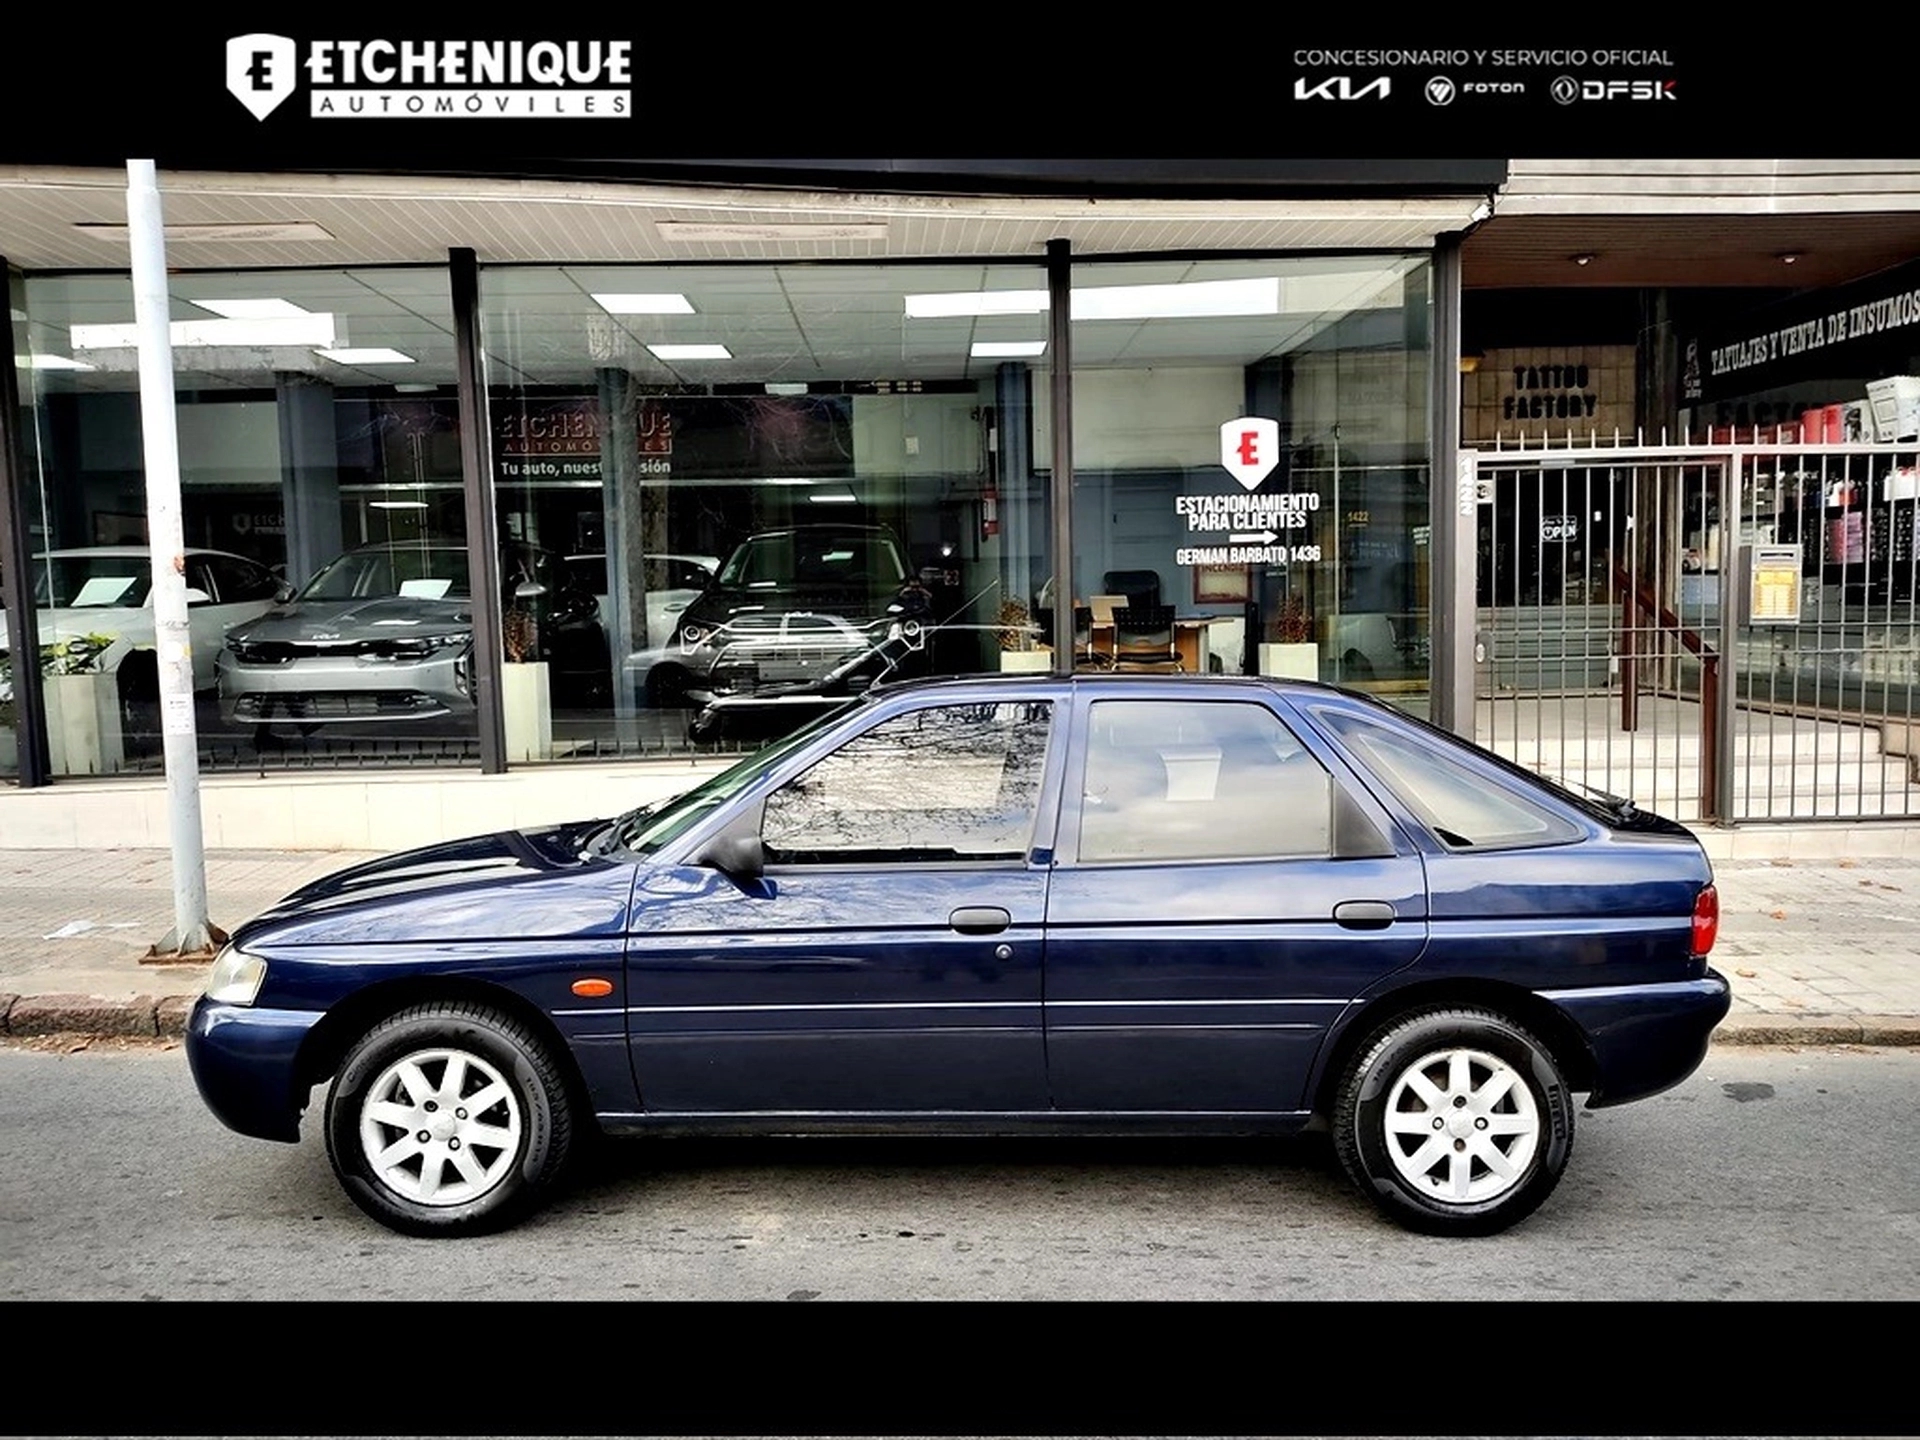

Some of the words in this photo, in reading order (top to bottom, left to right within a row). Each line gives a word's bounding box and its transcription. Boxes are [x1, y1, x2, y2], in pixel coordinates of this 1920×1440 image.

[1711, 335, 1768, 375] TATUAJES
[1769, 331, 1779, 360] Y
[1780, 318, 1825, 357] VENTA
[1827, 311, 1848, 344] DE
[1849, 289, 1920, 339] INSUMOS
[1513, 365, 1588, 389] TATTOO
[1503, 395, 1597, 419] FACTORY
[499, 413, 672, 437] ETCHENUE
[504, 440, 668, 453] AUTOMÓES
[501, 462, 518, 475] Tu
[522, 462, 560, 477] auto,
[1176, 493, 1319, 514] ESTACIONAMIENTO
[1188, 513, 1230, 531] PARA
[1233, 511, 1307, 529] CLIENTES
[1176, 547, 1228, 565] GERMAN
[1230, 546, 1288, 563] BARBATO
[1290, 545, 1321, 561] 1436
